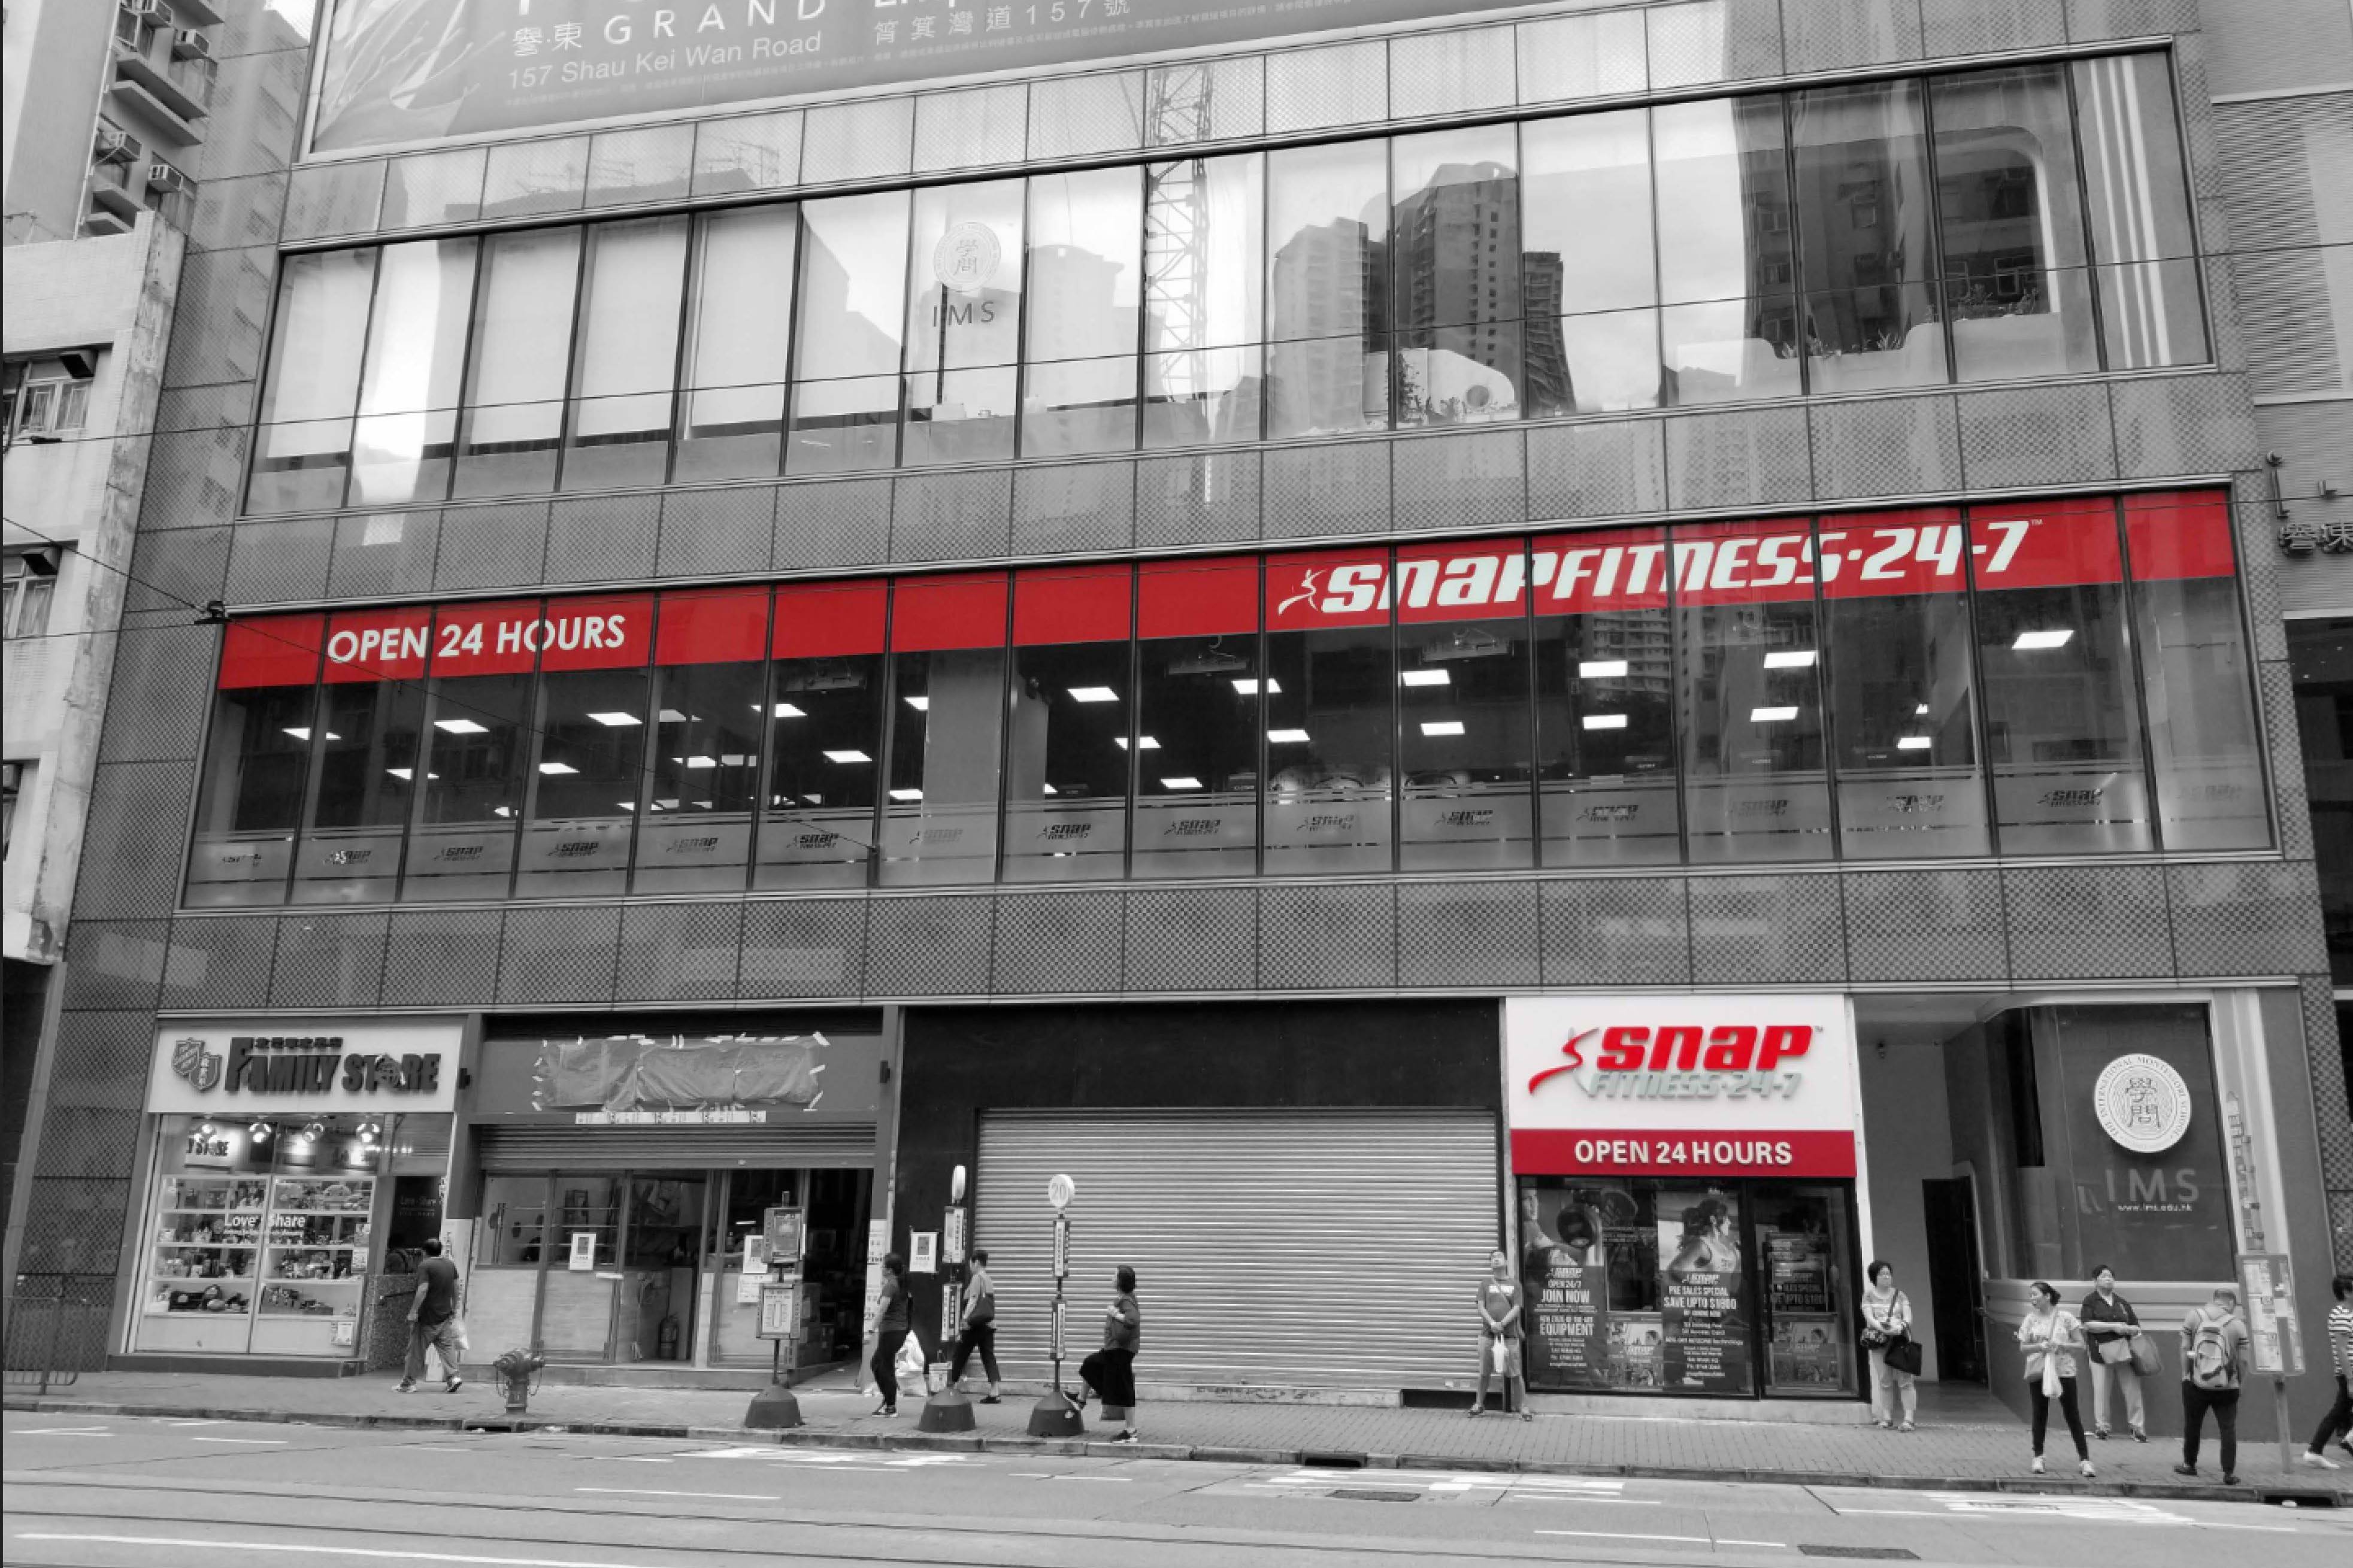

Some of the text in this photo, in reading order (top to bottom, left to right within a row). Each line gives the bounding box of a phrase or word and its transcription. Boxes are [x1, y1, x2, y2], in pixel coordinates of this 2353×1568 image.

[604, 0, 825, 44] GRAND
[508, 65, 553, 89] 157
[561, 58, 625, 83] Shau
[635, 50, 675, 72] Kei
[685, 44, 742, 67] Wan
[752, 31, 821, 59] Road
[933, 300, 995, 327] IMS
[328, 615, 625, 663] OPEN 24 HOURS
[225, 1037, 342, 1091] FAMILY
[1574, 1140, 1792, 1166] OPEN 24 HOURS
[2104, 1169, 2199, 1202] IMS
[225, 1214, 255, 1227] Love
[1541, 1289, 1590, 1303] JOIN NOW
